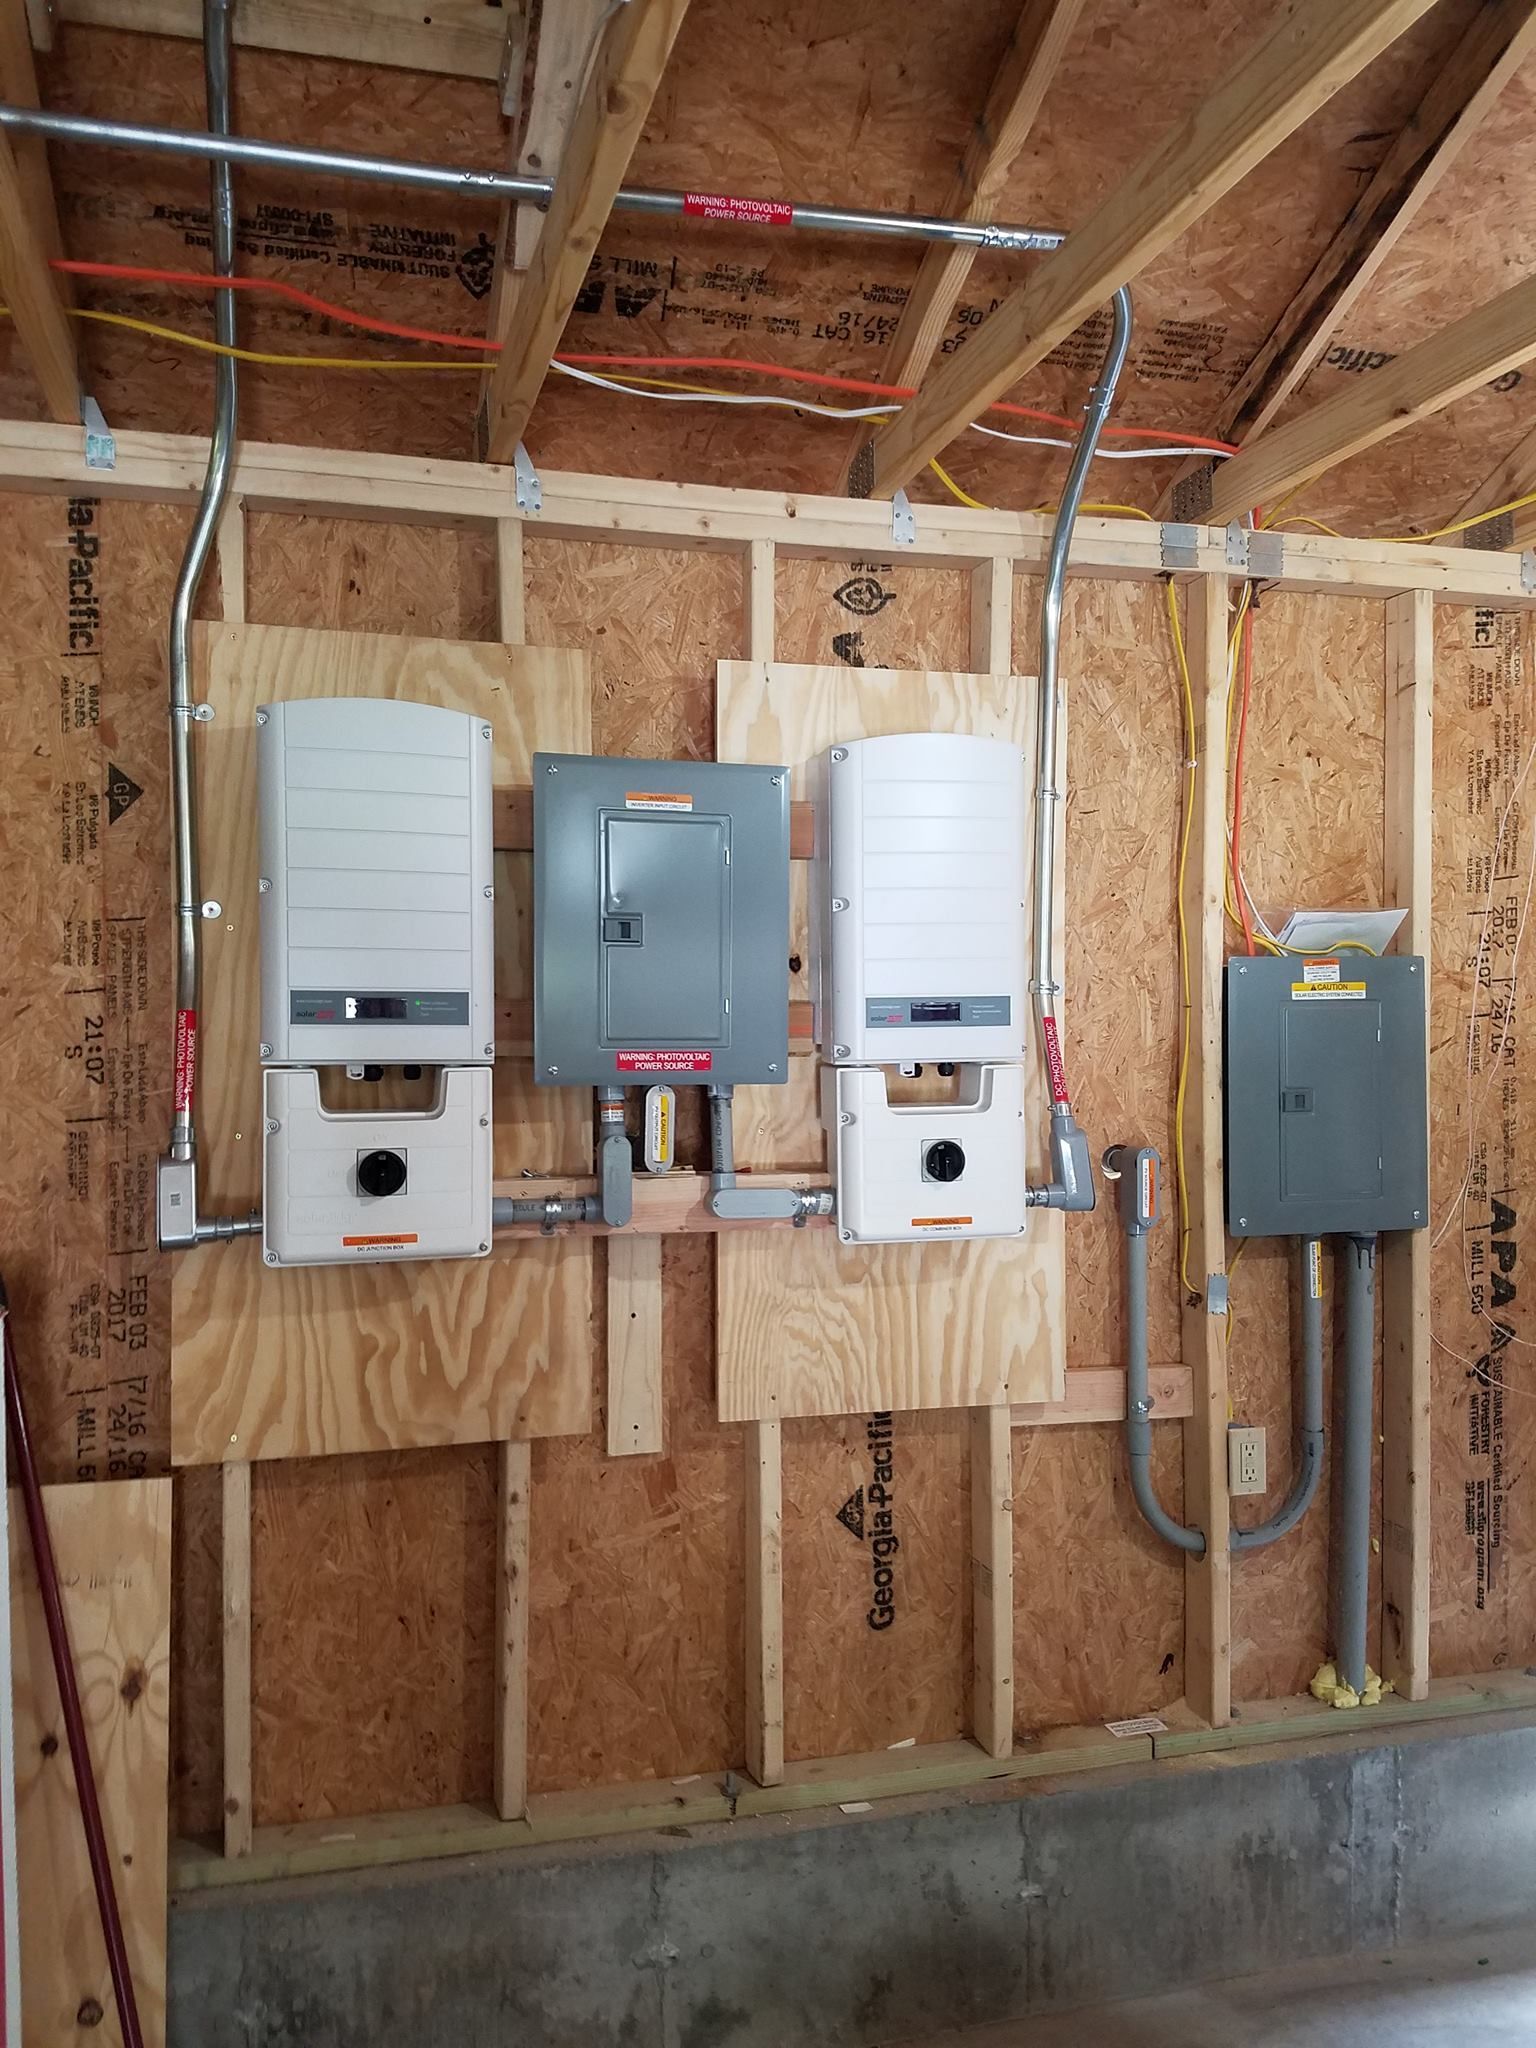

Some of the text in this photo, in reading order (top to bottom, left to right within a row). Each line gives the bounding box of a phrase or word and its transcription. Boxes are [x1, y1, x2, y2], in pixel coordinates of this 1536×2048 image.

[687, 193, 791, 216] WARNING: PHOTOVOLTAIC
[704, 207, 771, 224] POWER SOURCE
[609, 257, 657, 279] MILL
[812, 322, 851, 341] CAT
[1327, 346, 1398, 373] cific
[67, 497, 100, 650] ia-Pacific
[112, 781, 131, 806] GP
[1491, 905, 1505, 949] 2017
[1505, 897, 1518, 933] FEB
[1317, 983, 1349, 991] CAUTION
[84, 1015, 105, 1085] 21:07
[176, 1011, 187, 1068] PHOTOVOLTAIC
[186, 1028, 196, 1061] SOURCE
[1490, 998, 1504, 1055] 24/16
[634, 1061, 694, 1071] POWER SOURCE
[656, 1052, 711, 1062] PHOTOVOLTAIC
[1045, 1022, 1062, 1083] PHOTOVOLTAIC
[1502, 1036, 1517, 1068] CAT
[1470, 1241, 1484, 1281] MILL
[1490, 1197, 1517, 1308] APA
[107, 1287, 127, 1343] 2017
[128, 1275, 148, 1351] FEB 03
[76, 1407, 96, 1459] MILL
[107, 1403, 127, 1475] 24/16
[128, 1378, 148, 1479] 7/16 CA
[1468, 1393, 1480, 1457] INITIATIVE
[1478, 1391, 1491, 1456] FORESTRY
[1490, 1356, 1505, 1549] SUSTAINABLE Certified Sourcing
